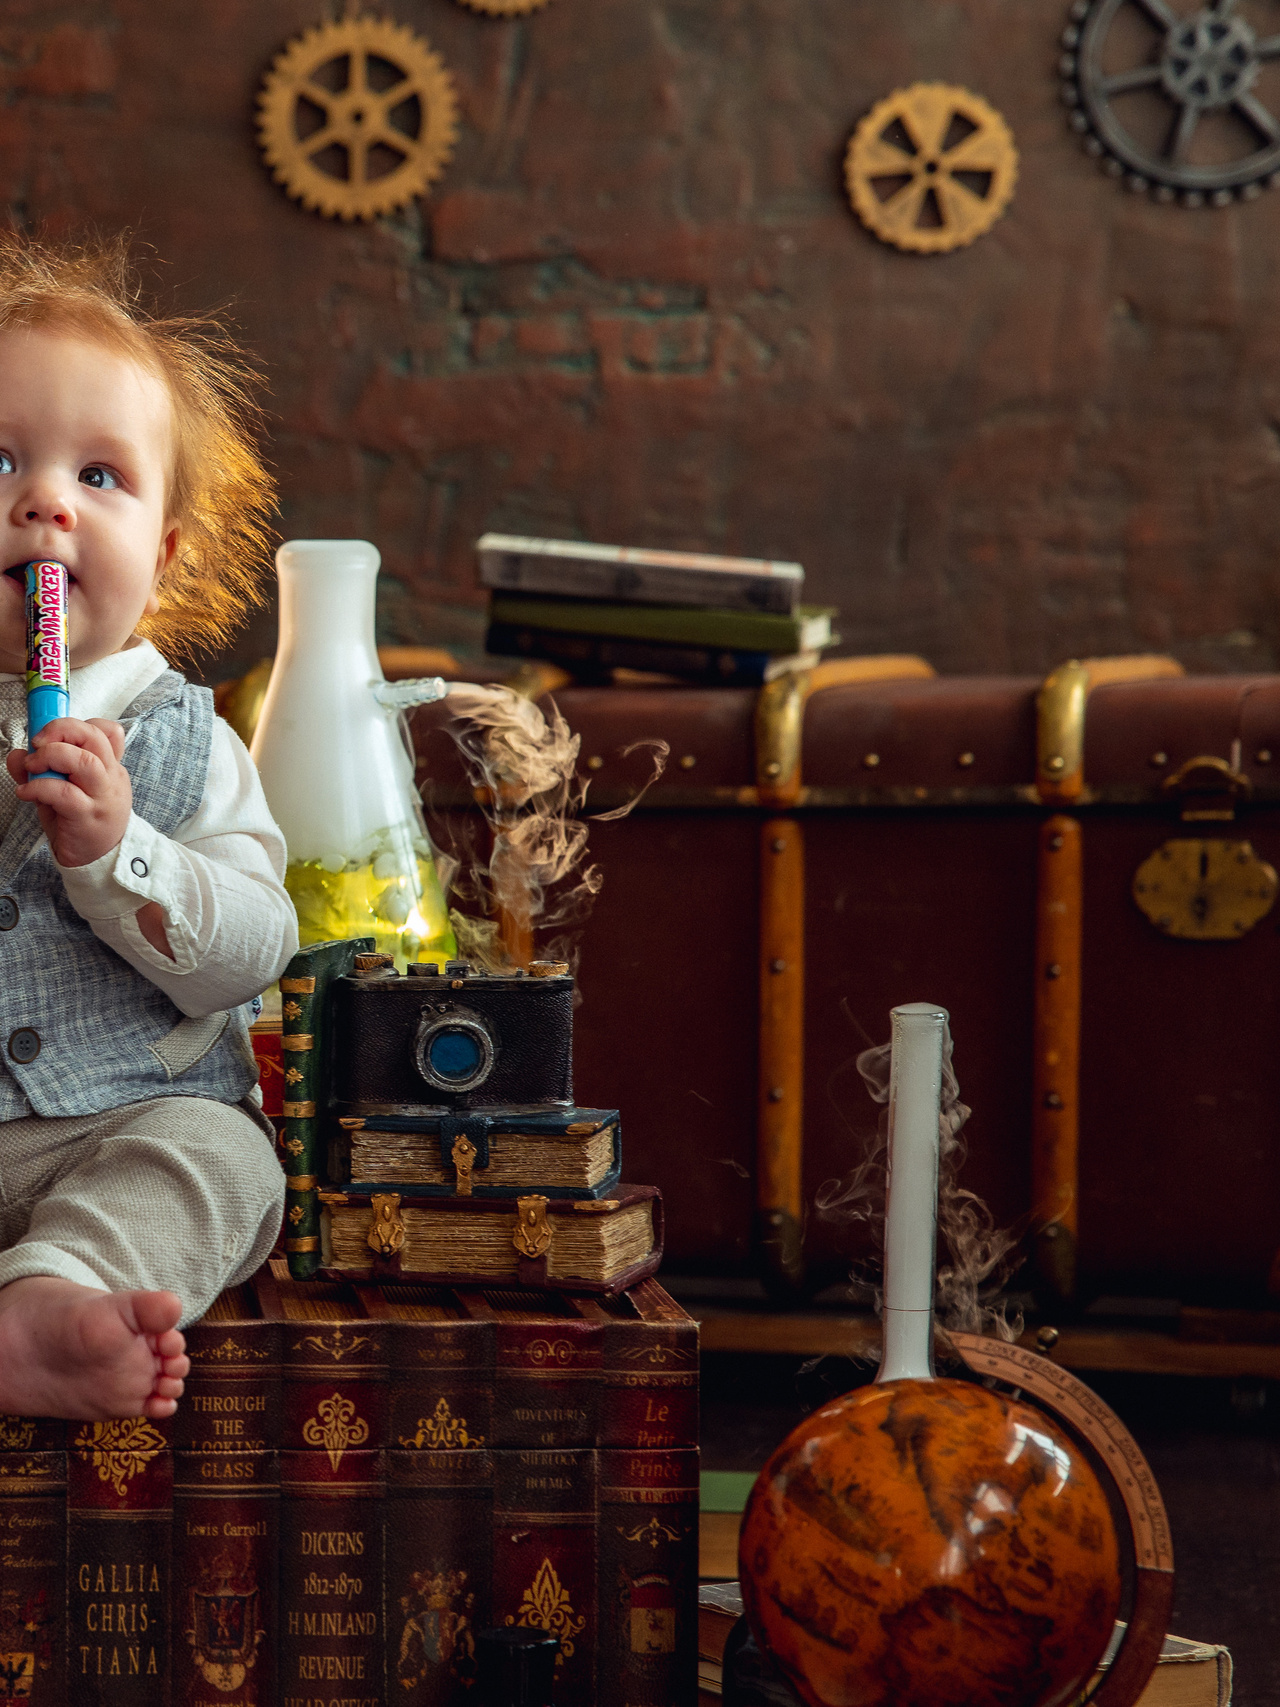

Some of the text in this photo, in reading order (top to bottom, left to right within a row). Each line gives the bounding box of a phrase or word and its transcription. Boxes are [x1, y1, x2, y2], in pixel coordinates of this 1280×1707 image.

[39, 563, 63, 685] MEGA MARKER
[192, 1396, 266, 1412] THROUGH
[644, 1398, 670, 1422] Le
[213, 1419, 245, 1435] THE
[201, 1462, 255, 1478] GLASS
[630, 1458, 681, 1477] Prince
[186, 1521, 267, 1537] Lewis Carroll
[301, 1531, 365, 1556] DICKENS
[79, 1563, 160, 1593] GALLIA
[304, 1571, 363, 1601] 1812-1870
[86, 1602, 157, 1638] CHRIS-
[79, 1646, 159, 1675] TIANA
[298, 1655, 365, 1680] REVENUE
